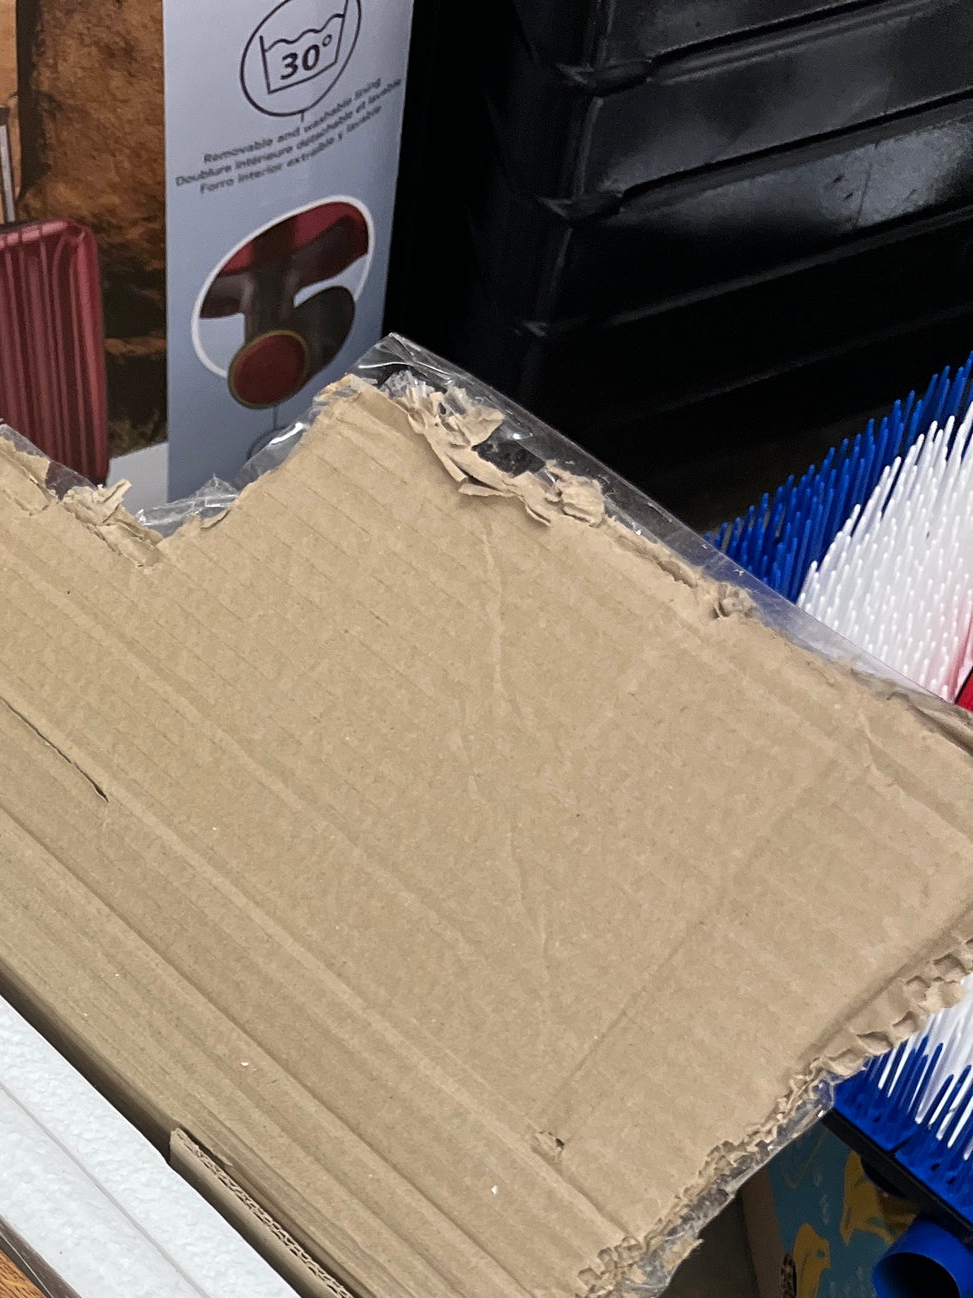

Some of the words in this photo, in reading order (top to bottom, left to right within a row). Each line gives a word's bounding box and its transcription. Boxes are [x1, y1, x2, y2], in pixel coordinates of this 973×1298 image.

[176, 165, 232, 186] Doublure
[356, 101, 366, 113] et
[368, 78, 402, 104] lavable
[199, 178, 234, 195] Forro
[238, 163, 283, 182] interior
[346, 106, 382, 132] lavable
[203, 138, 273, 163] Removable
[278, 126, 300, 142] and
[304, 98, 352, 132] washable
[354, 78, 381, 100] lining
